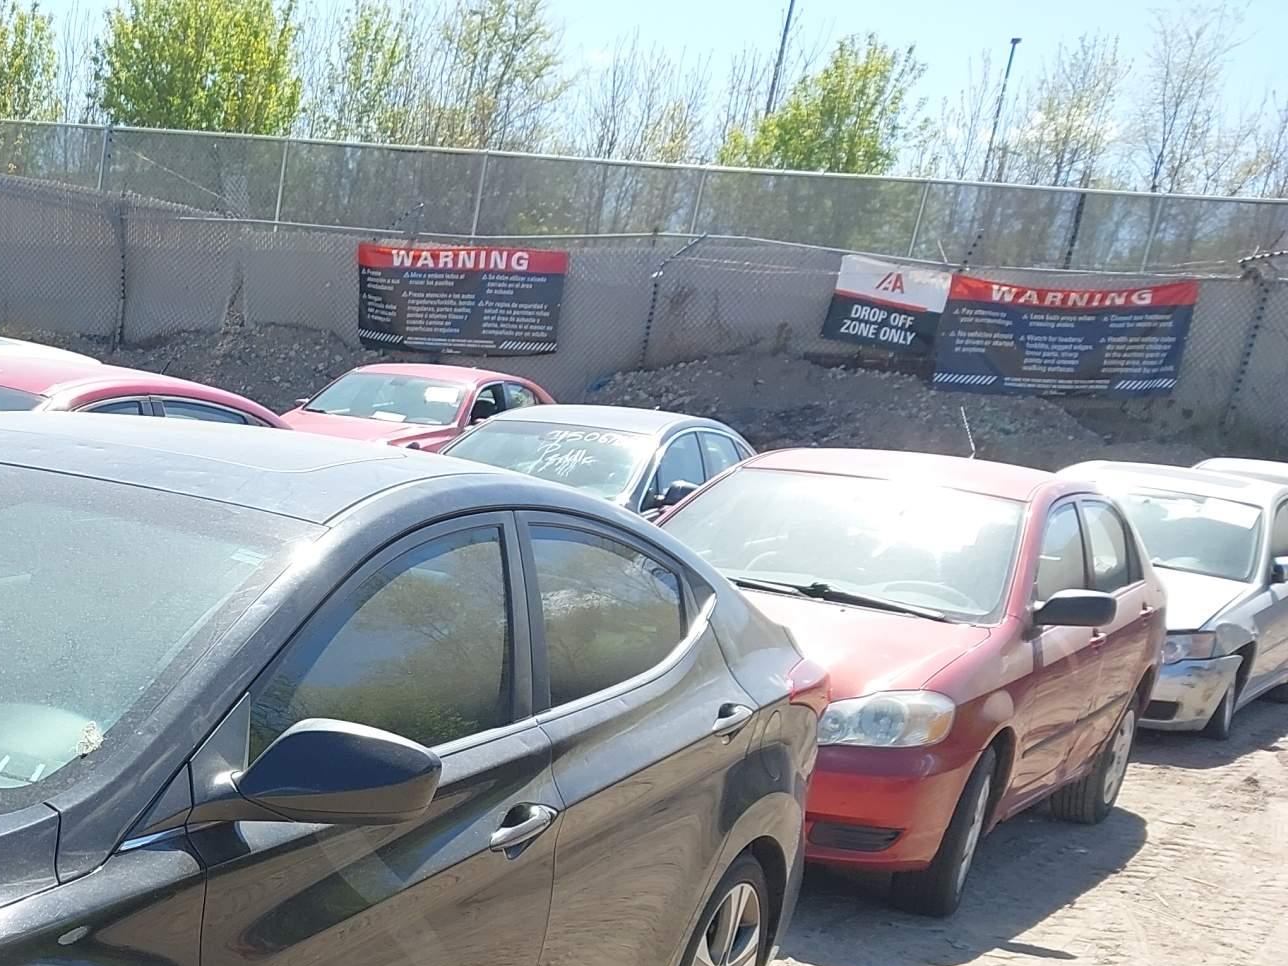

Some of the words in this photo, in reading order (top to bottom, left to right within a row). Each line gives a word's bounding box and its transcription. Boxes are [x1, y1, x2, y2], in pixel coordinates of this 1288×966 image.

[391, 249, 529, 270] WARNING
[991, 284, 1153, 306] WARNING
[851, 304, 887, 323] DROP
[890, 312, 915, 328] OFF
[840, 319, 879, 338] ZONE
[880, 326, 916, 344] ONLY
